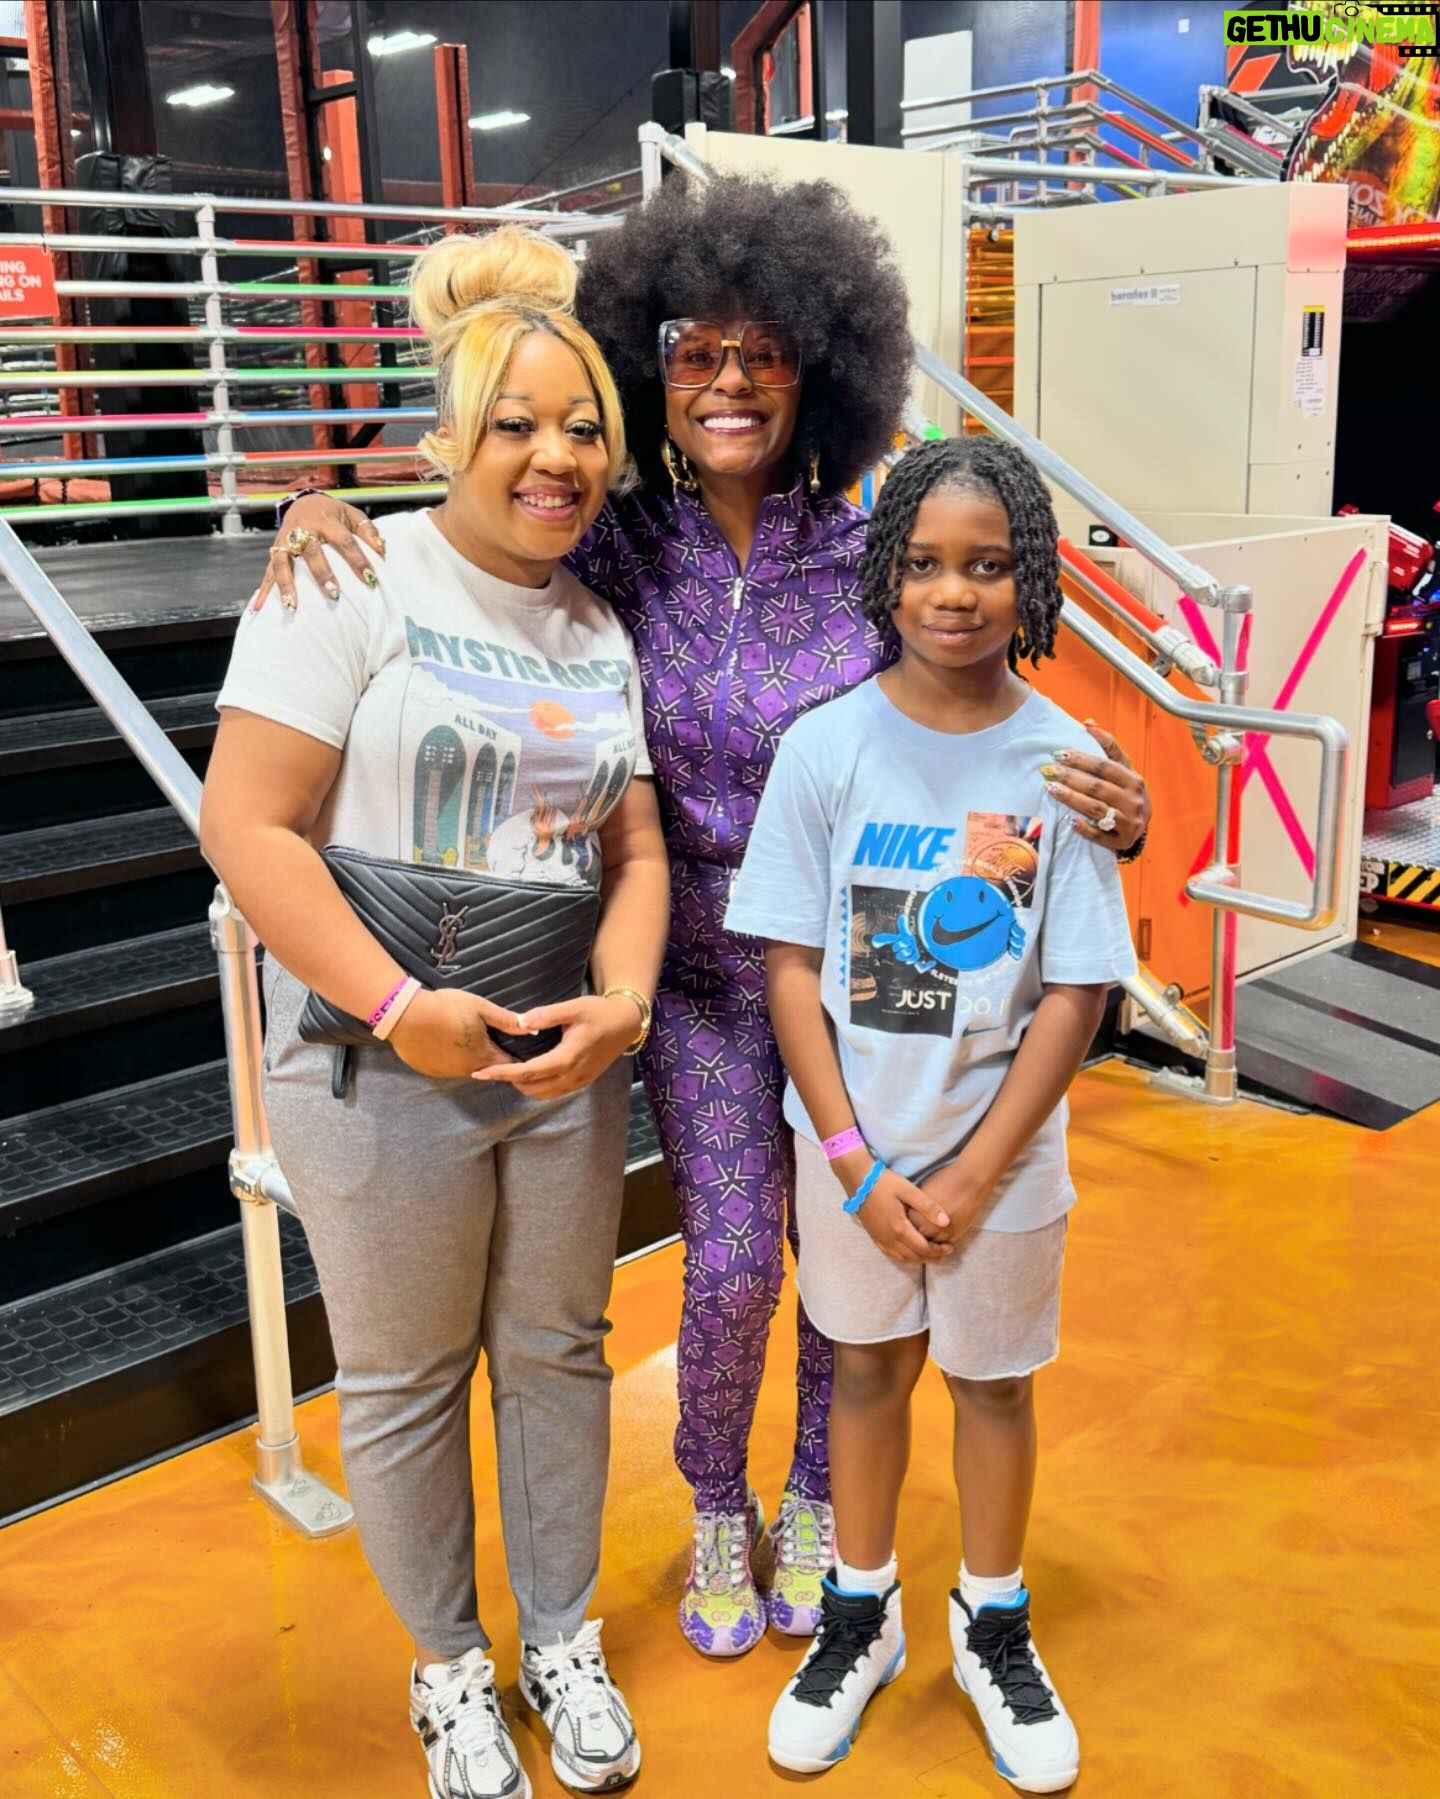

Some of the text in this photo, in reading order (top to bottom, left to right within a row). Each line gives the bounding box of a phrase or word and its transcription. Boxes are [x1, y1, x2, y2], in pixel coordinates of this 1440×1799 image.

[18, 274, 42, 289] ON
[404, 615, 550, 685] MYSTIC
[454, 714, 497, 741] ALL DAY
[853, 822, 956, 872] NIKE
[895, 989, 953, 1011] JUST
